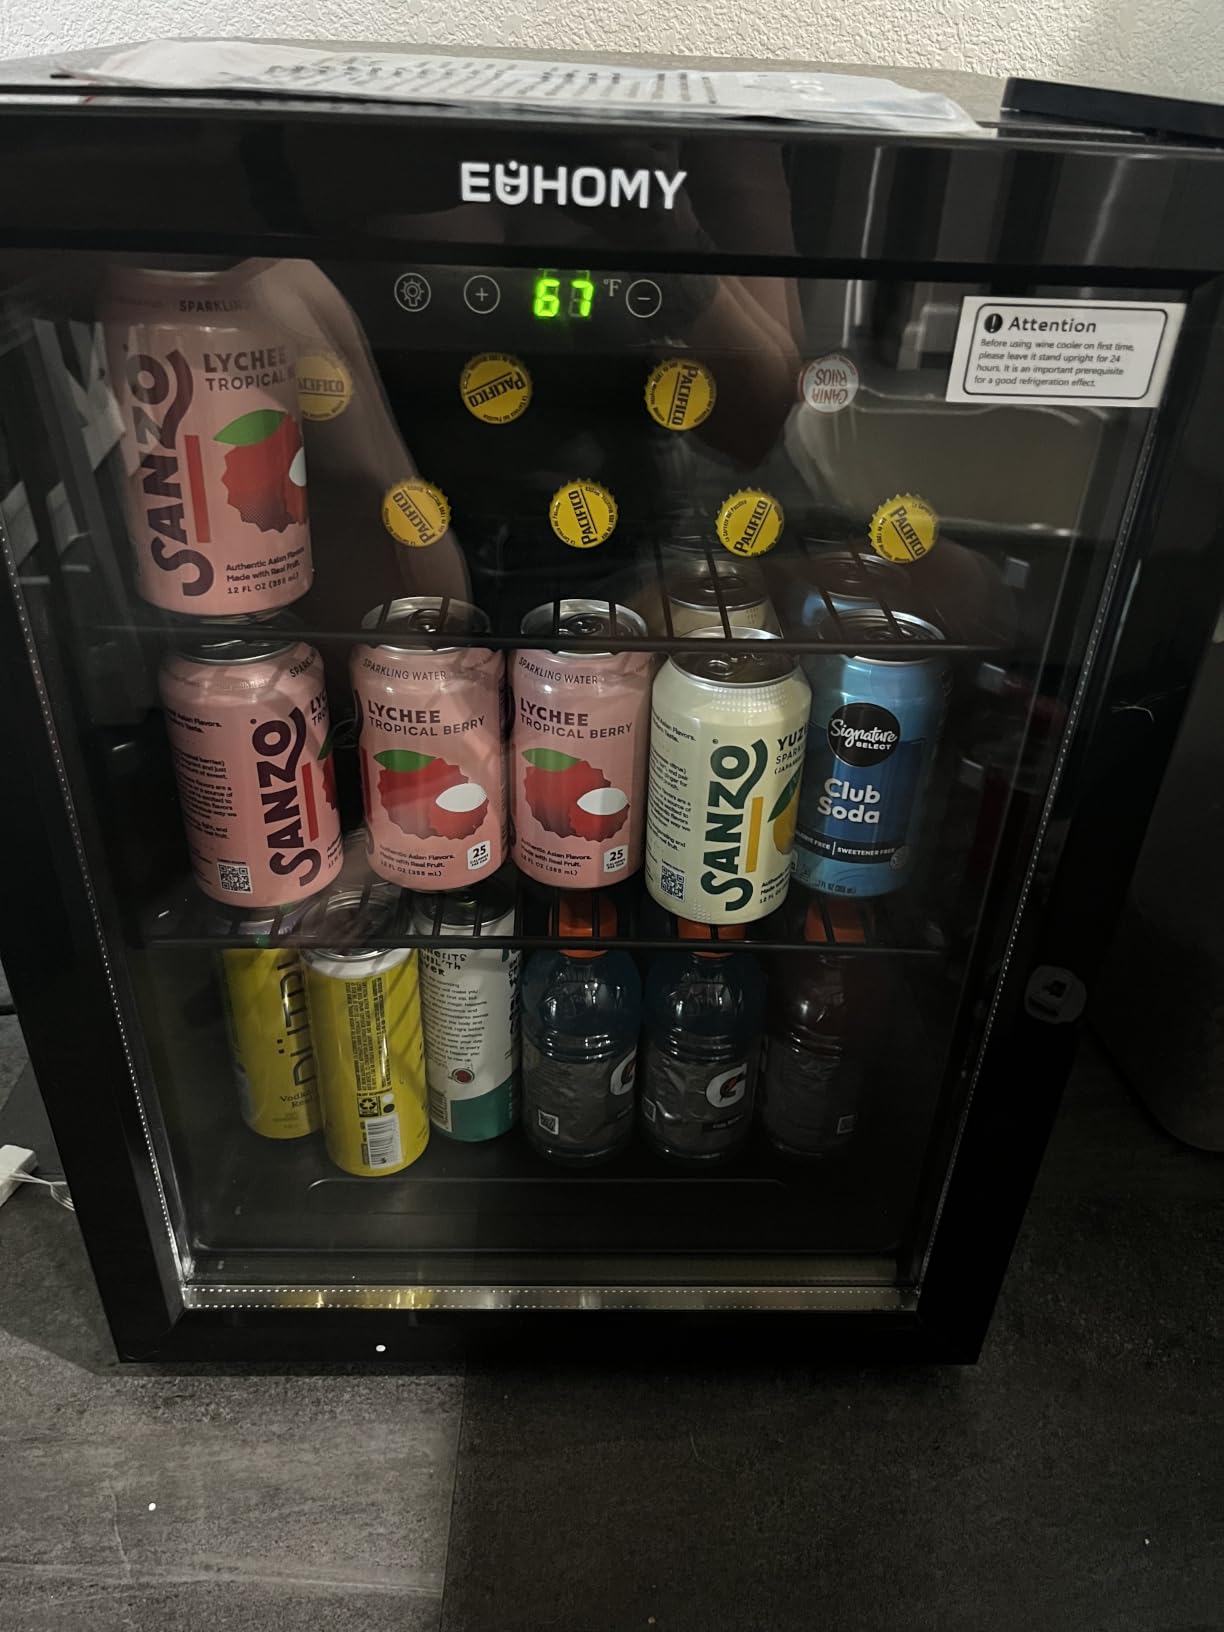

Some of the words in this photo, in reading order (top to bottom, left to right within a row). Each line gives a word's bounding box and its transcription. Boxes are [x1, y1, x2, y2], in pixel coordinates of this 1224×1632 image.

[461, 160, 687, 210] EUHOMY
[533, 278, 594, 317] 67
[1008, 316, 1097, 333] Attention
[978, 351, 1005, 361] please
[1007, 352, 1028, 361] leave
[1030, 352, 1036, 361] it
[1038, 353, 1061, 361] stand
[1063, 353, 1093, 364] upright
[1096, 354, 1108, 362] for
[1109, 354, 1121, 363] 24
[980, 338, 1007, 348] Before
[1009, 340, 1032, 350] using
[1035, 341, 1054, 349] wine
[1056, 340, 1083, 350] cooler
[1097, 341, 1113, 351] first
[203, 345, 286, 374] LYCHEE
[976, 363, 1001, 373] hours.
[1004, 364, 1010, 373] It
[1012, 364, 1018, 373] is
[1033, 365, 1072, 375] important
[1075, 366, 1124, 377] prerequisite
[205, 372, 284, 392] TROPICAL
[468, 371, 526, 407] PACIFICO
[974, 375, 985, 384] for
[995, 376, 1017, 387] good
[1019, 377, 1069, 388] refrigeration
[1071, 378, 1096, 387] effect.
[672, 364, 699, 426] PACIFICO
[127, 350, 214, 596] SANZO
[393, 491, 436, 543] PACIFICO
[568, 490, 598, 545] PACIFICO
[733, 500, 769, 553] PACIFICO
[890, 505, 926, 557] PACIFICO
[226, 560, 267, 571] Authentic
[226, 574, 251, 582] Made
[252, 570, 270, 579] with
[362, 658, 409, 680] SPARKLING
[412, 670, 447, 681] WATER
[518, 657, 562, 682] SPARKLING
[564, 674, 599, 685] WATER
[367, 699, 441, 724] LYCHEE
[520, 697, 589, 727] LYCHEE
[369, 716, 438, 736] TROPICAL
[443, 715, 485, 736] BERRY
[520, 714, 585, 739] TROPICAL
[590, 722, 633, 739] BERRY
[830, 719, 898, 748] Signature
[856, 741, 892, 750] SELECT
[252, 706, 322, 887] SANZO
[824, 778, 881, 804] Club
[817, 796, 880, 824] Soda
[701, 738, 768, 911] SANZO
[472, 844, 486, 859] 25
[609, 849, 623, 862] 25
[837, 847, 879, 856] SWEETENER
